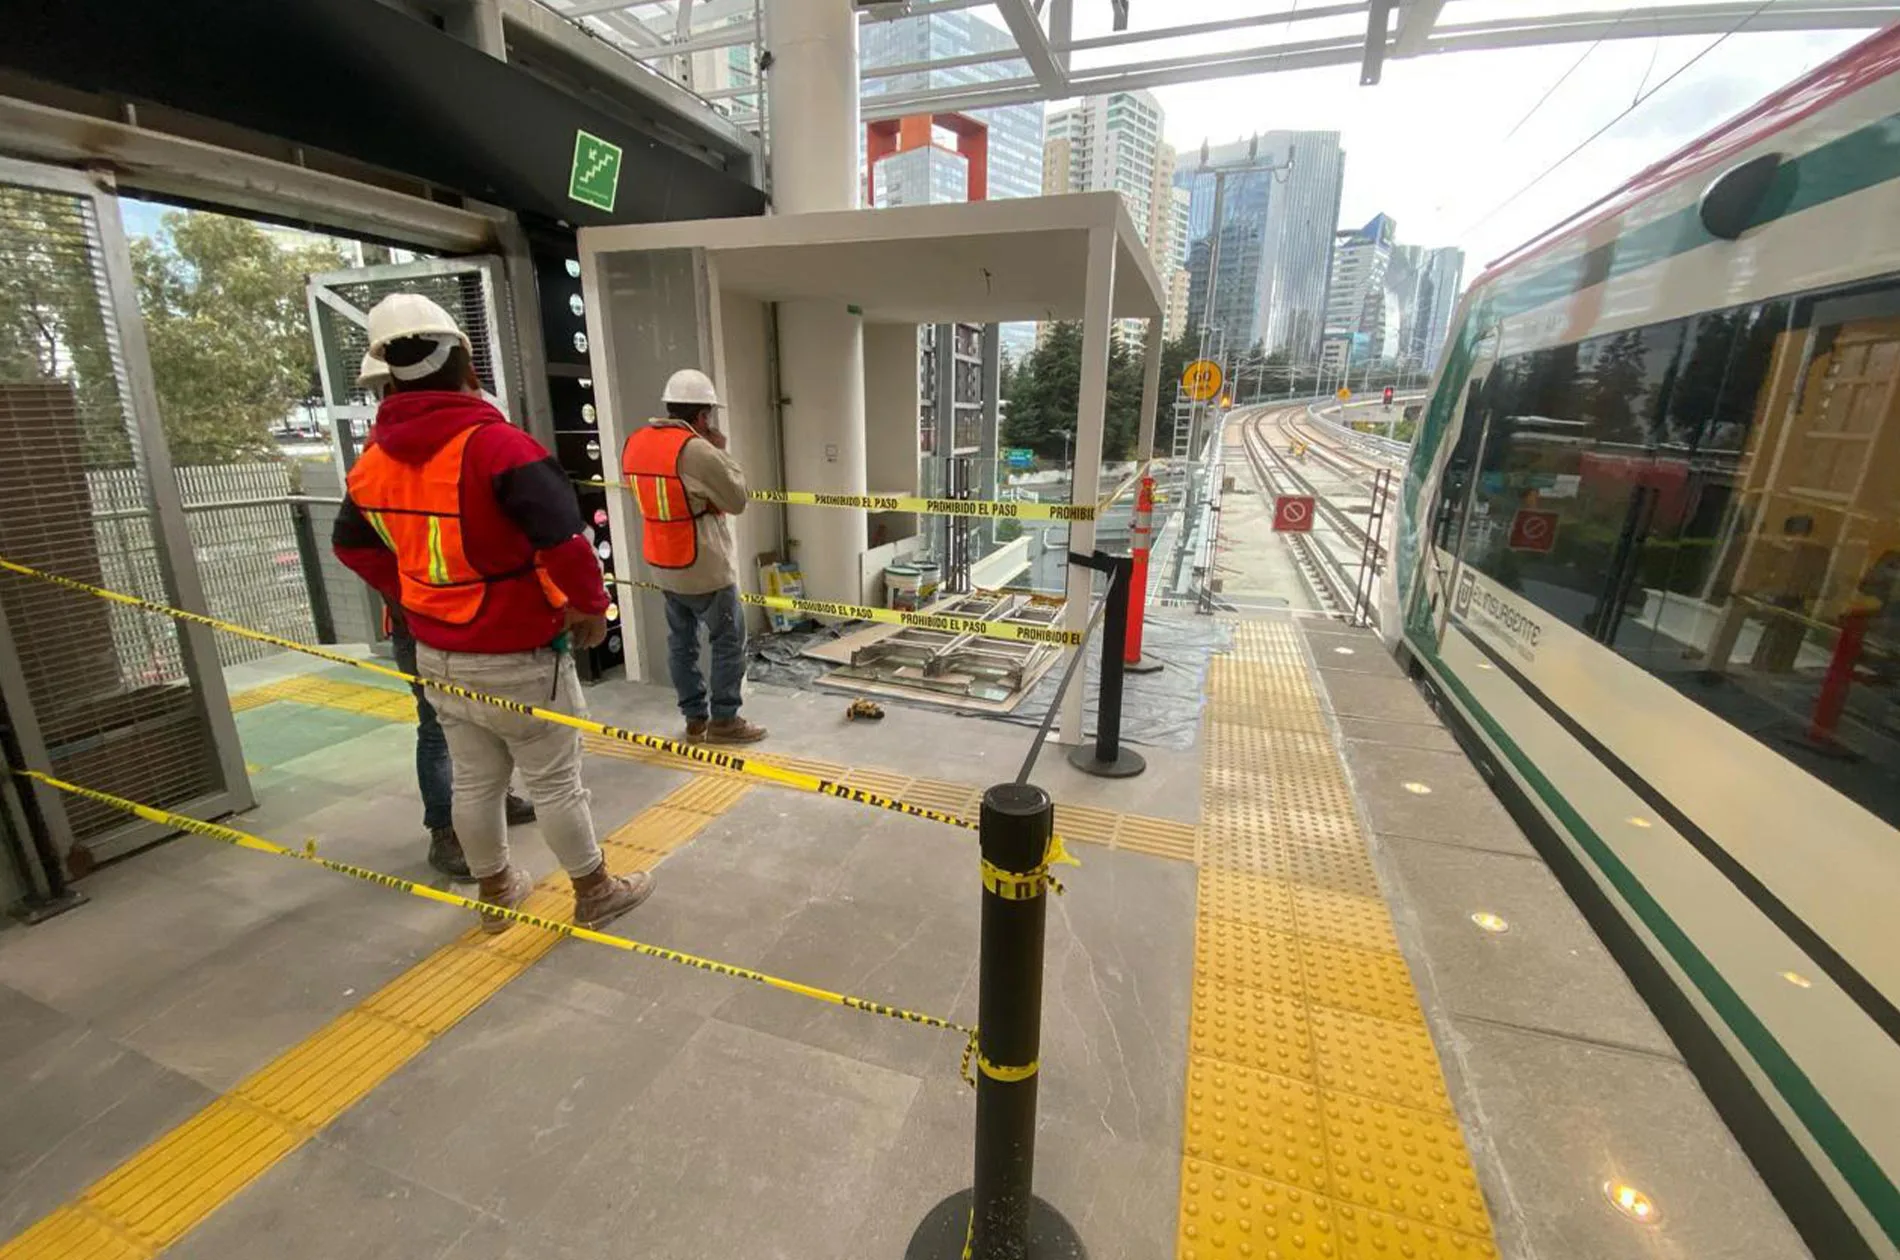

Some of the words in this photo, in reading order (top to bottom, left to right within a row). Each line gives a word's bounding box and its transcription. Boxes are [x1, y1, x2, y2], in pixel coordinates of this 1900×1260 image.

[814, 494, 860, 508] PROHIBIDO
[861, 498, 872, 509] EL
[874, 498, 898, 510] PASO
[926, 500, 976, 514] PROHIBIDO
[978, 503, 989, 516] EL
[992, 504, 1017, 518] PASO
[791, 599, 837, 615] PROHIBIDO
[838, 607, 849, 617] EL
[850, 607, 874, 620] PASO
[900, 612, 949, 630] PROHIBIDO
[949, 619, 961, 632] EL
[962, 621, 987, 635] PASO
[1016, 626, 1069, 644] PROHIBIDO
[1071, 632, 1081, 646] EL
